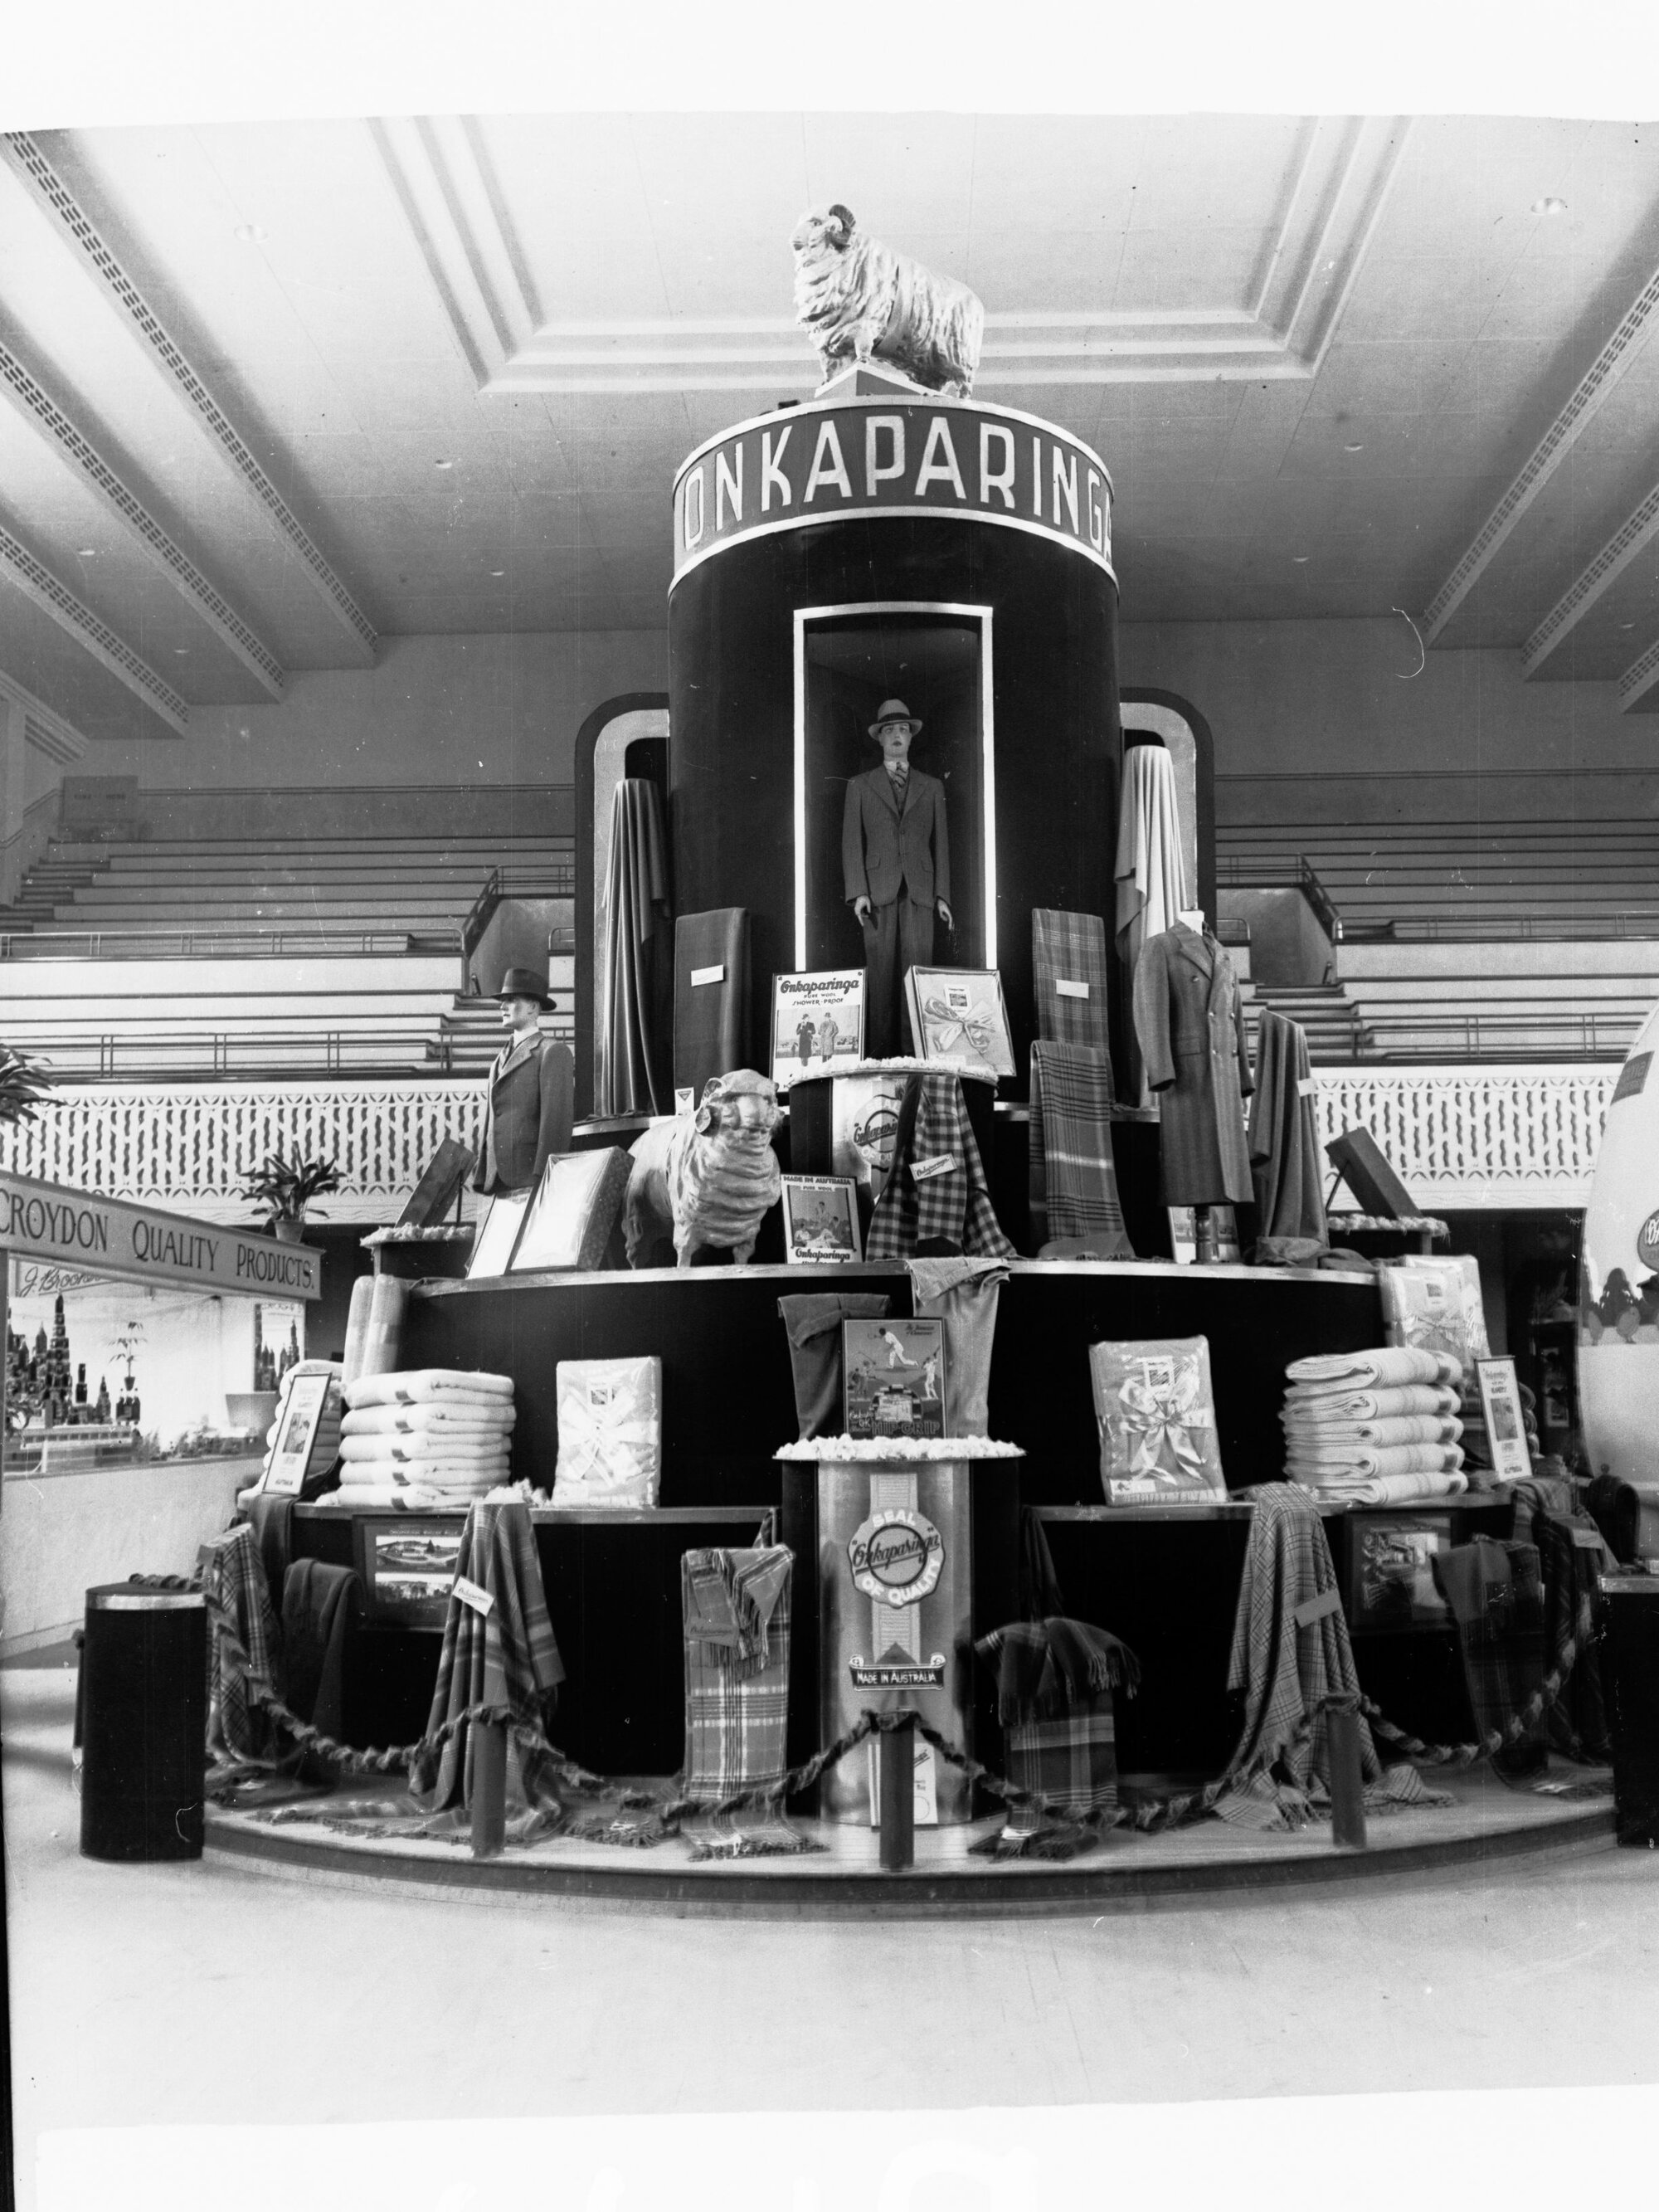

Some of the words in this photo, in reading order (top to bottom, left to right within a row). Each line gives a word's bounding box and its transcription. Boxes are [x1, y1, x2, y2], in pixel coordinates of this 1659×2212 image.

[780, 977, 859, 995] Onkaparinga
[133, 1220, 219, 1271] QUALITY
[795, 1248, 850, 1263] Onkaparinga
[873, 1509, 916, 1528] SEAL
[862, 1576, 884, 1596] OF
[888, 1558, 941, 1605] QUALITY
[857, 1669, 878, 1684] MADE
[881, 1669, 888, 1683] IN
[891, 1669, 937, 1684] AUSTRALIA
